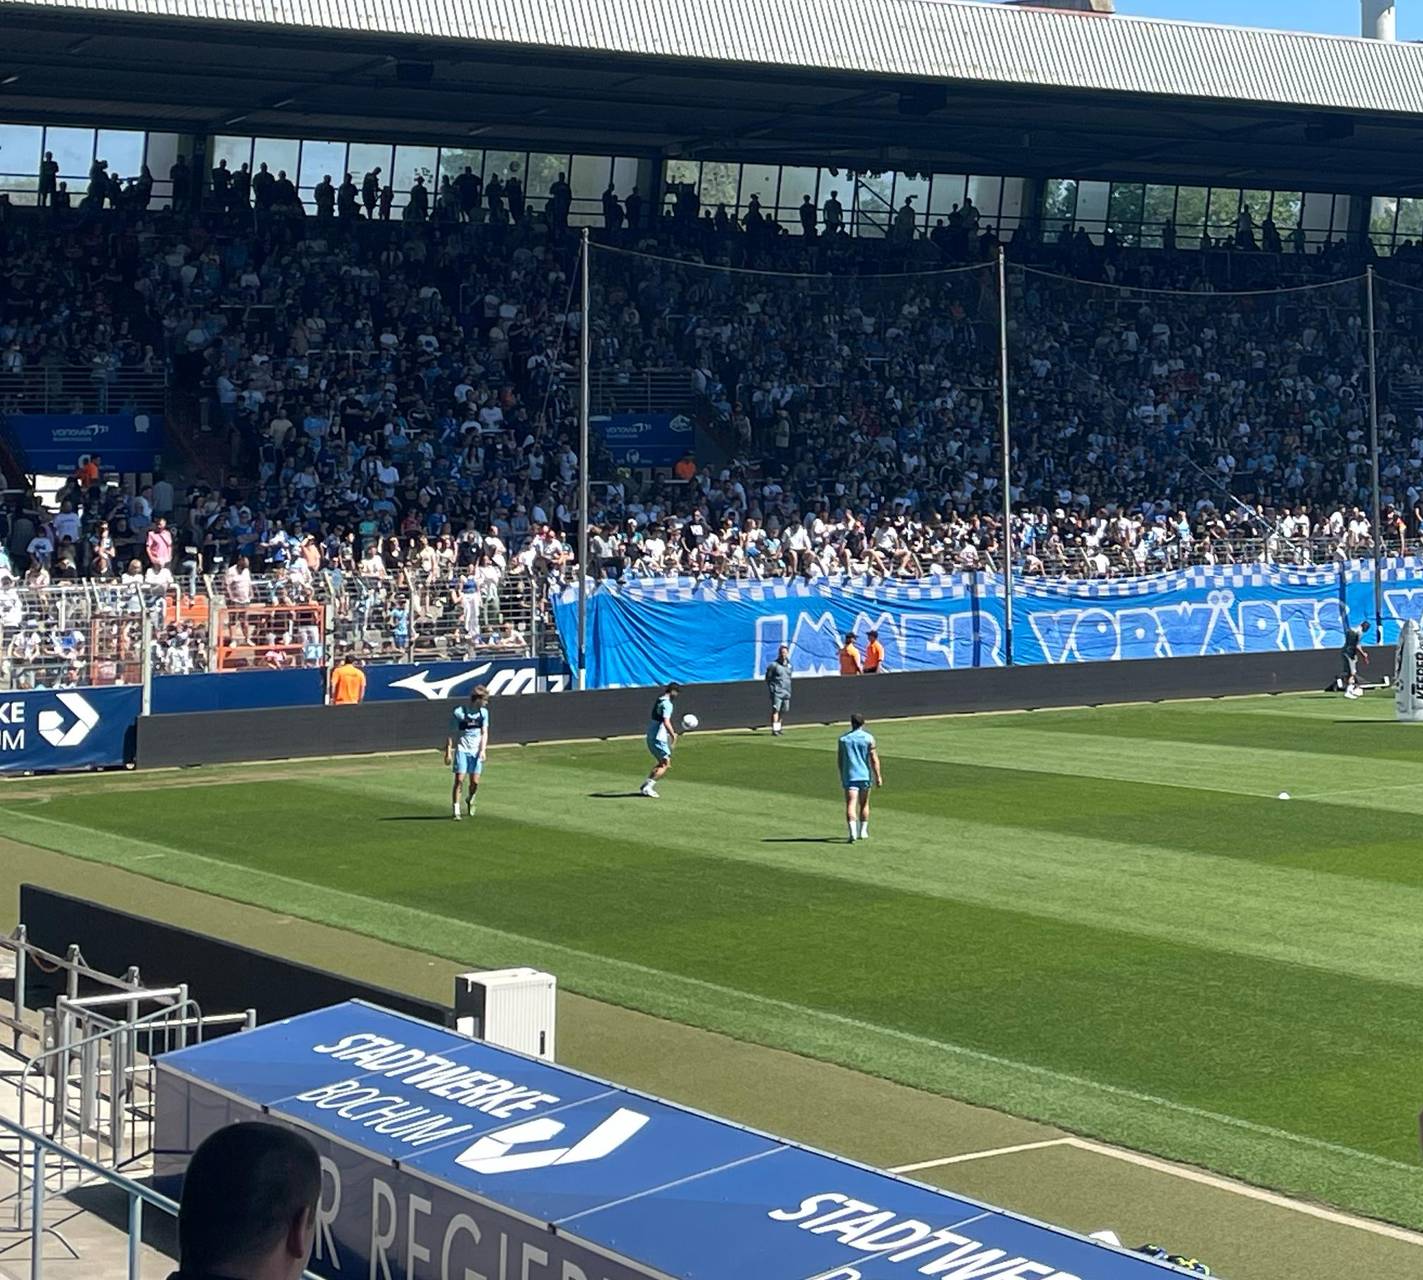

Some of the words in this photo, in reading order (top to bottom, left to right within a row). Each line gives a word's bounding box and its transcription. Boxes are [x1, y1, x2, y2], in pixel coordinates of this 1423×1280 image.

[1028, 589, 1349, 664] VORWÄRTS
[0, 729, 25, 751] M
[313, 1033, 560, 1118] STADTWERKE
[296, 1080, 473, 1146] BOCHUM
